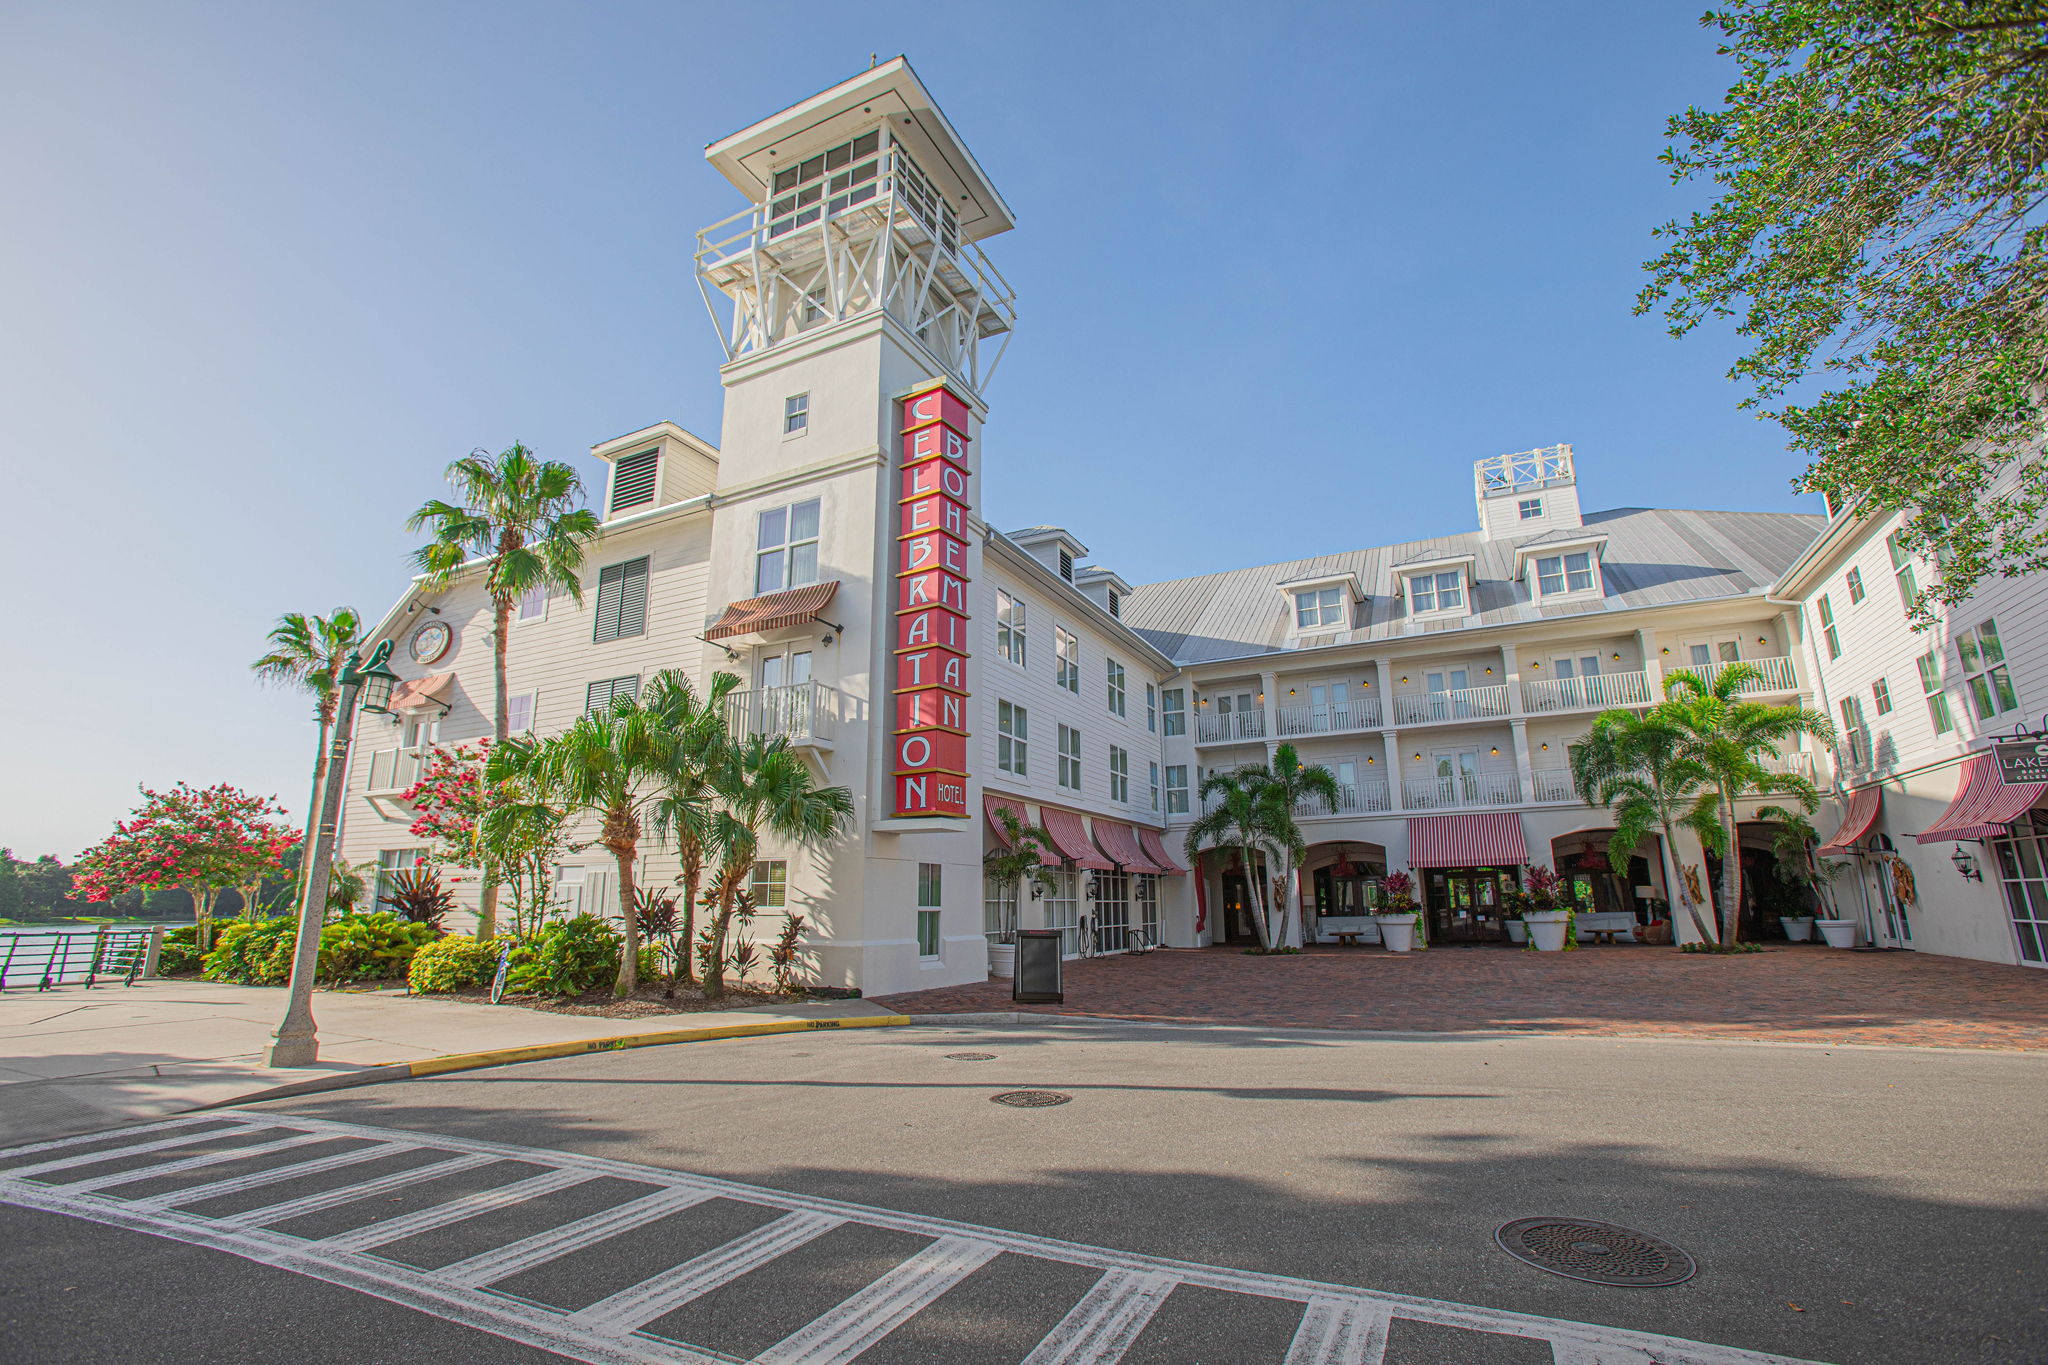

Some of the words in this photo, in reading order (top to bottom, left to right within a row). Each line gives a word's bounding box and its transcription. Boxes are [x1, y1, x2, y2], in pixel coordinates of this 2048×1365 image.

[902, 396, 933, 810] CELEBRATION
[942, 429, 965, 729] BOHEMIAN
[938, 783, 965, 805] HOTEL
[587, 1041, 597, 1050] NO
